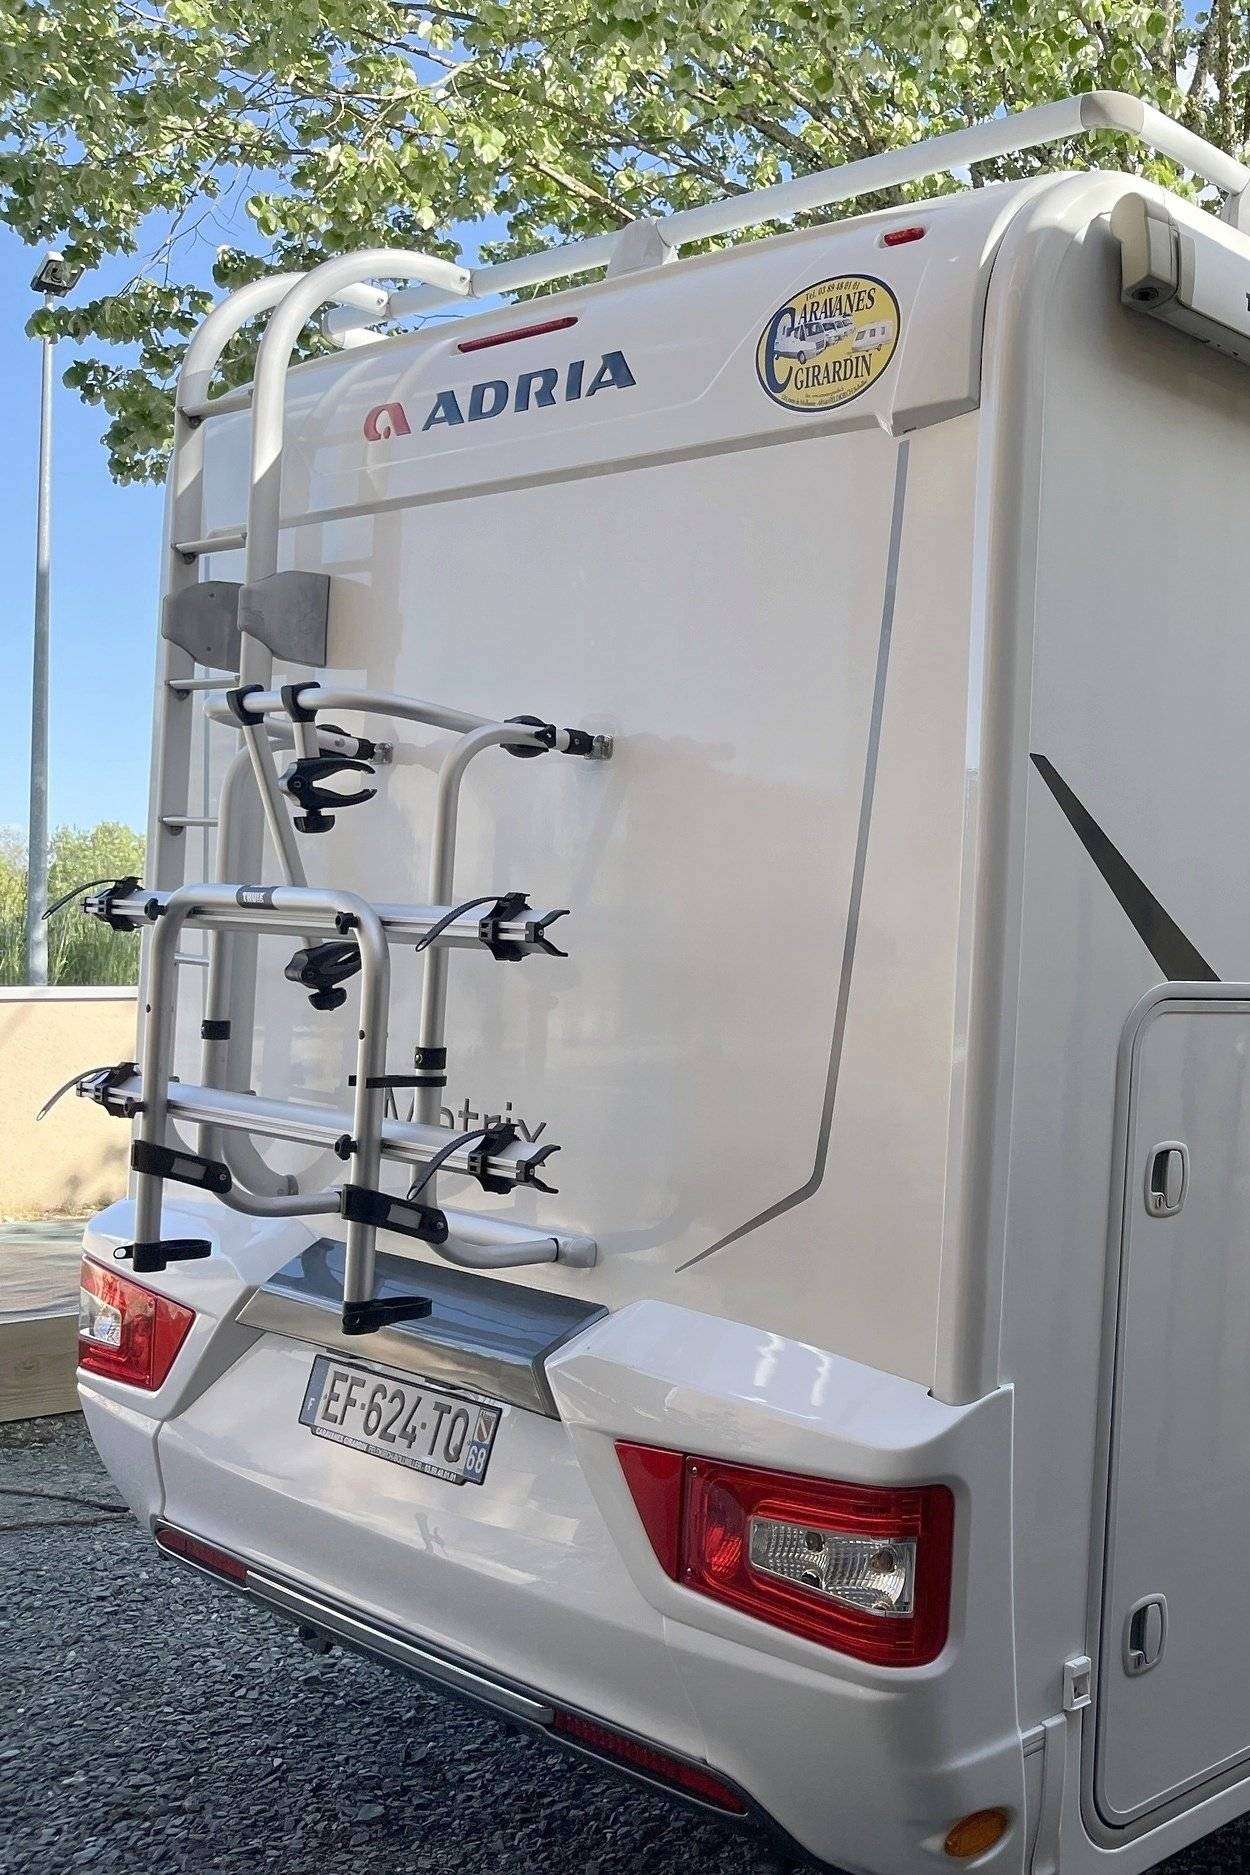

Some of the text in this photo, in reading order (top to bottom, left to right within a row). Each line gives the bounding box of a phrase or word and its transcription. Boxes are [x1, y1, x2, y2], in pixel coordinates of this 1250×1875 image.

[794, 353, 873, 390] GIRARDIN
[422, 350, 637, 432] ADRIA
[466, 1445, 487, 1474] 68
